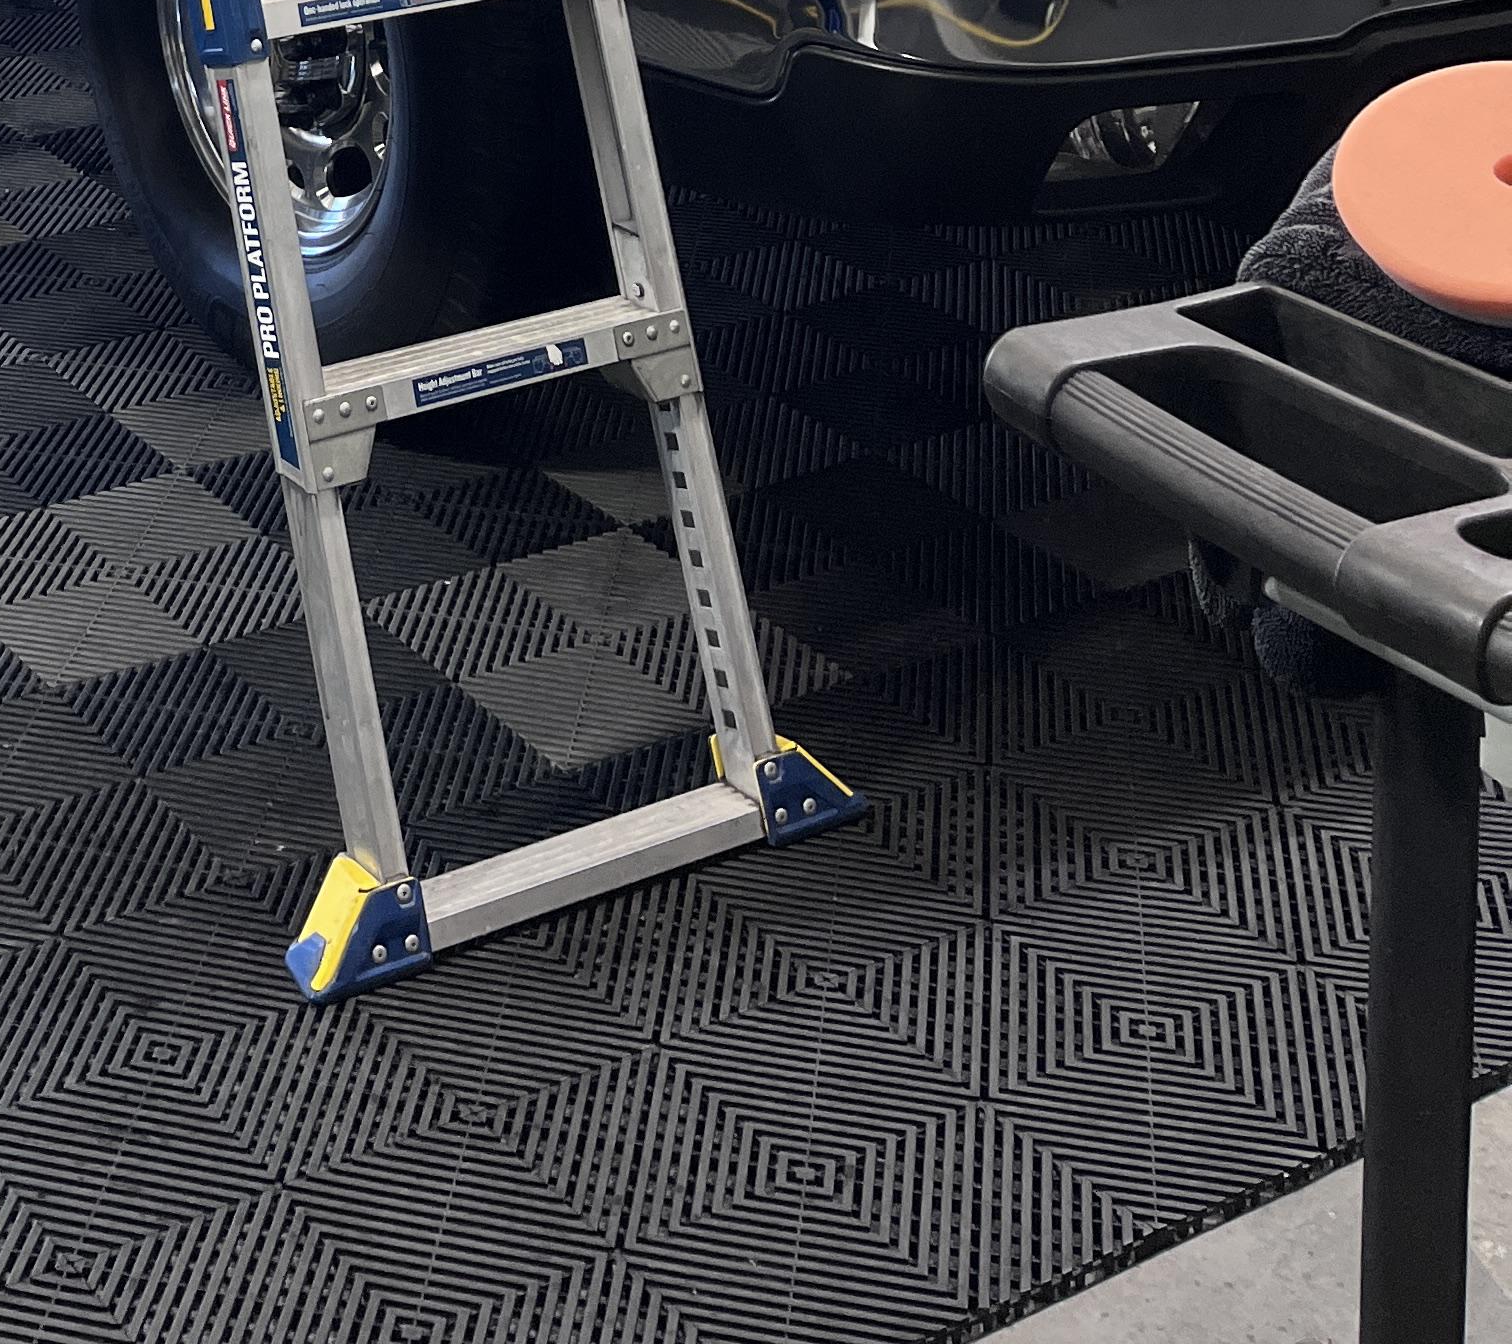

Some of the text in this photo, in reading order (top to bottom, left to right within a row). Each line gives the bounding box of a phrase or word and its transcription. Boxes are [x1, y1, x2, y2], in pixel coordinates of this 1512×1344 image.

[233, 161, 280, 360] PRO PLATFORM
[417, 378, 439, 393] Height
[471, 367, 483, 379] Bar
